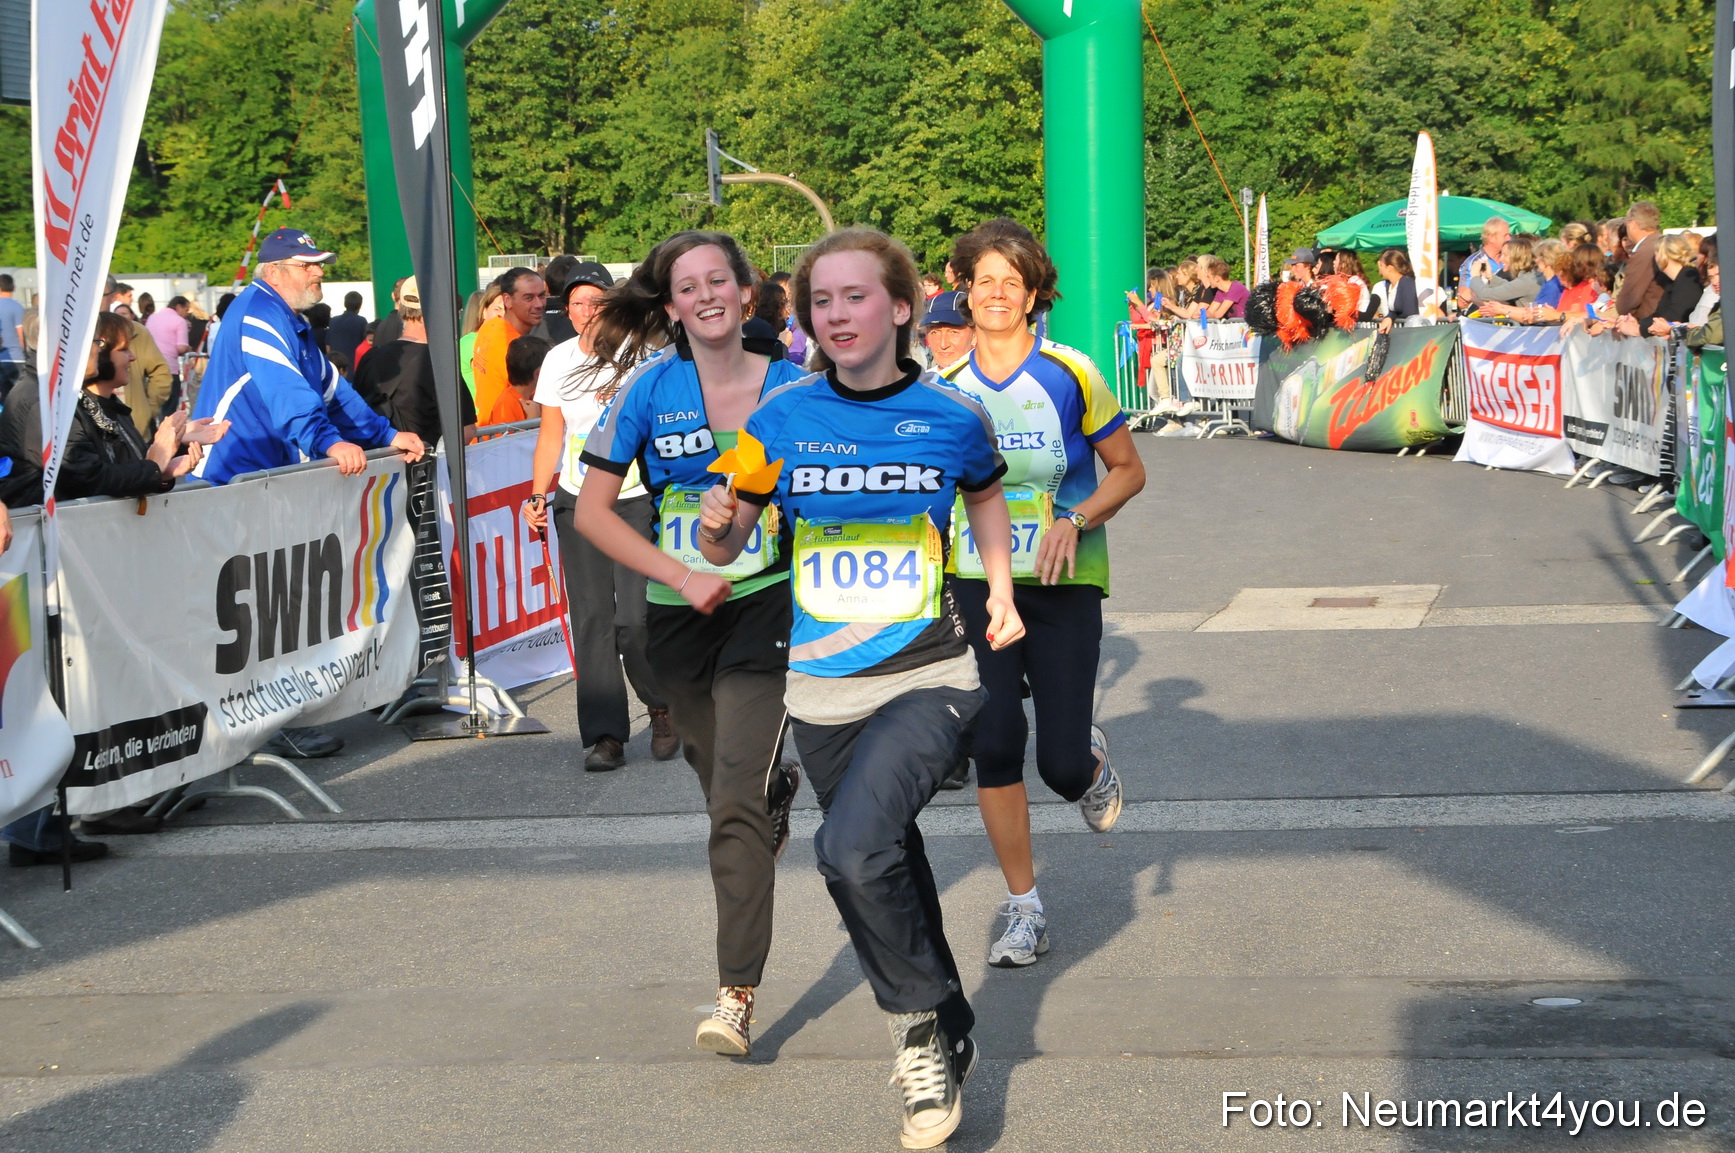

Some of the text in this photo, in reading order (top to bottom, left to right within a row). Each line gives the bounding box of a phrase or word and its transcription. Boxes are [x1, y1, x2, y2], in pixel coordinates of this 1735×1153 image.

[795, 441, 857, 456] TEAM
[789, 462, 945, 495] BOCK
[666, 516, 762, 554] 10
[814, 533, 860, 543] firmenlauf
[961, 523, 1039, 555] 167
[803, 550, 921, 589] 1084
[124, 737, 143, 759] die
